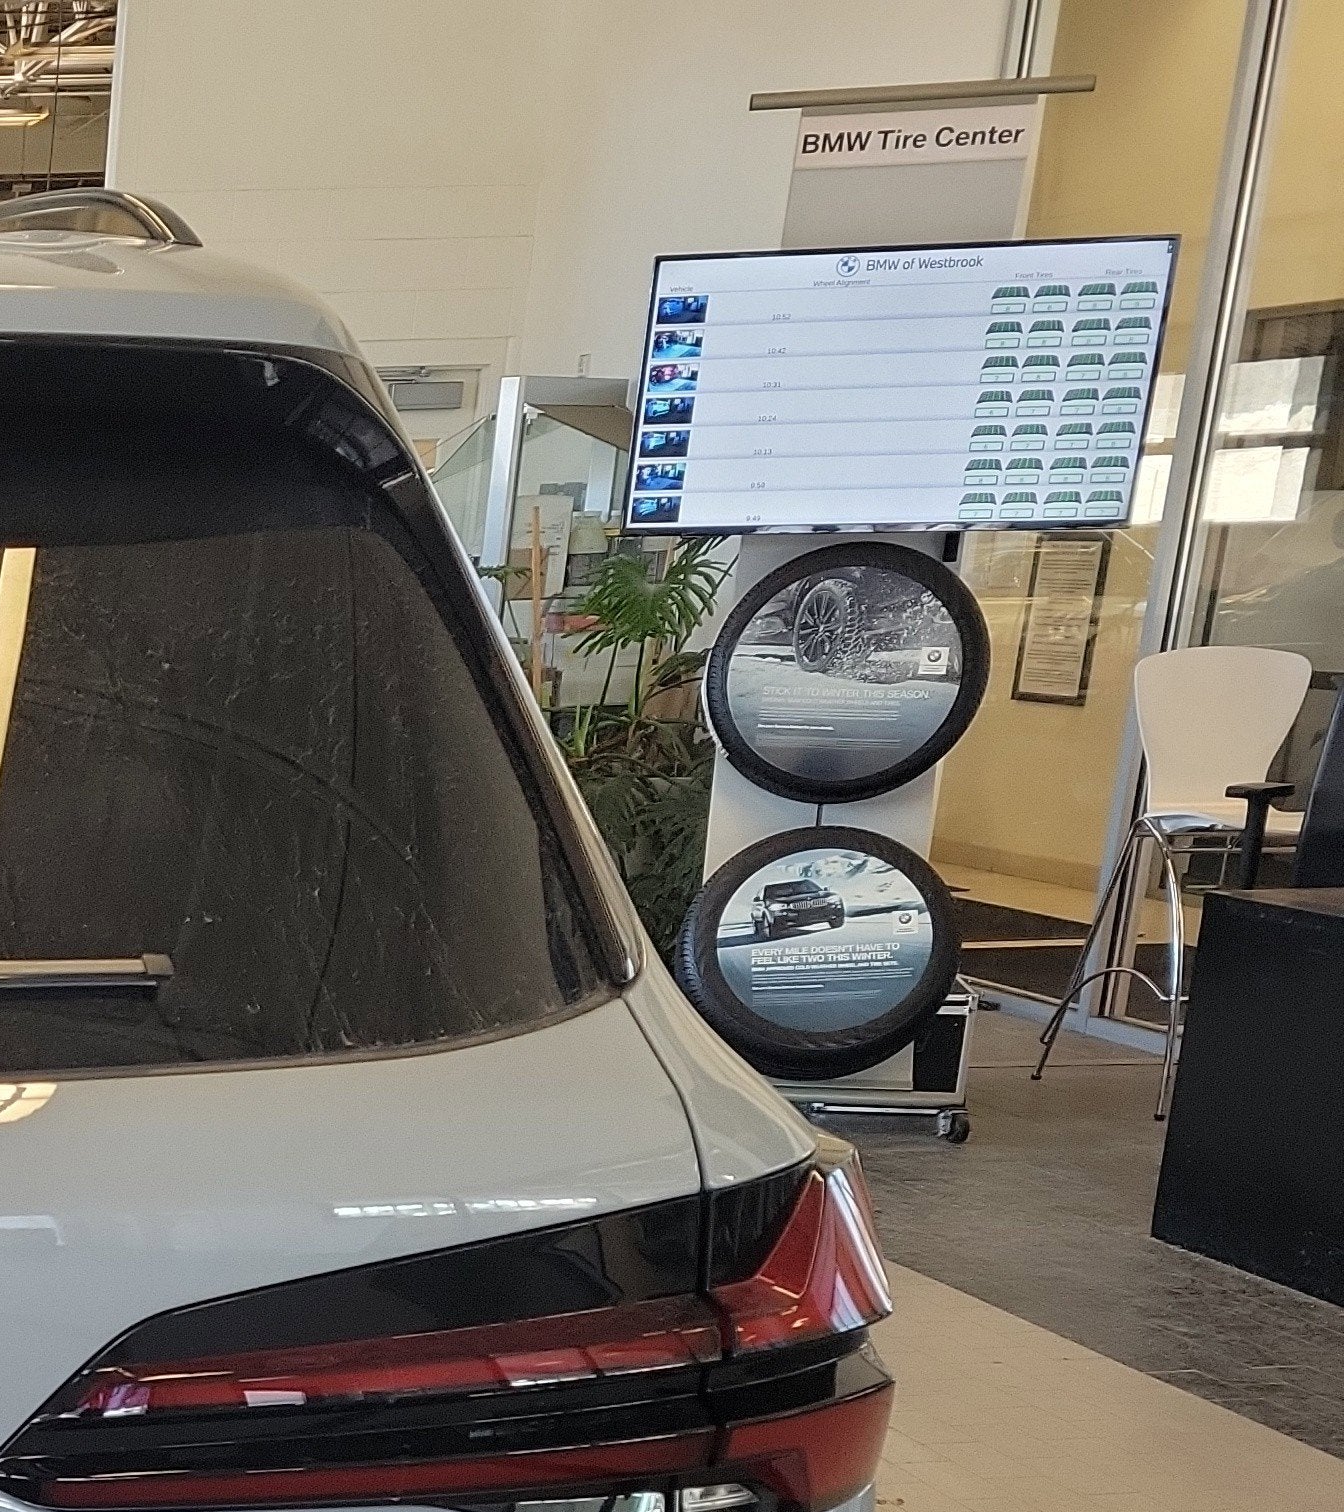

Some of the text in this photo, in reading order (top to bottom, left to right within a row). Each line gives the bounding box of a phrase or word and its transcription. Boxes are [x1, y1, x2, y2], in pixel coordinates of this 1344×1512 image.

[801, 126, 1026, 154] BMW Tire Center
[866, 255, 984, 271] BMW of Westbrook
[836, 279, 871, 288] Alignment
[763, 686, 931, 699] STICK IT TO WINTER THIS SEASON.
[752, 942, 900, 957] EVERY MILE DOESN'T HAVE TO
[752, 951, 893, 965] FEEL LIKE TWO THIS WINTER.
